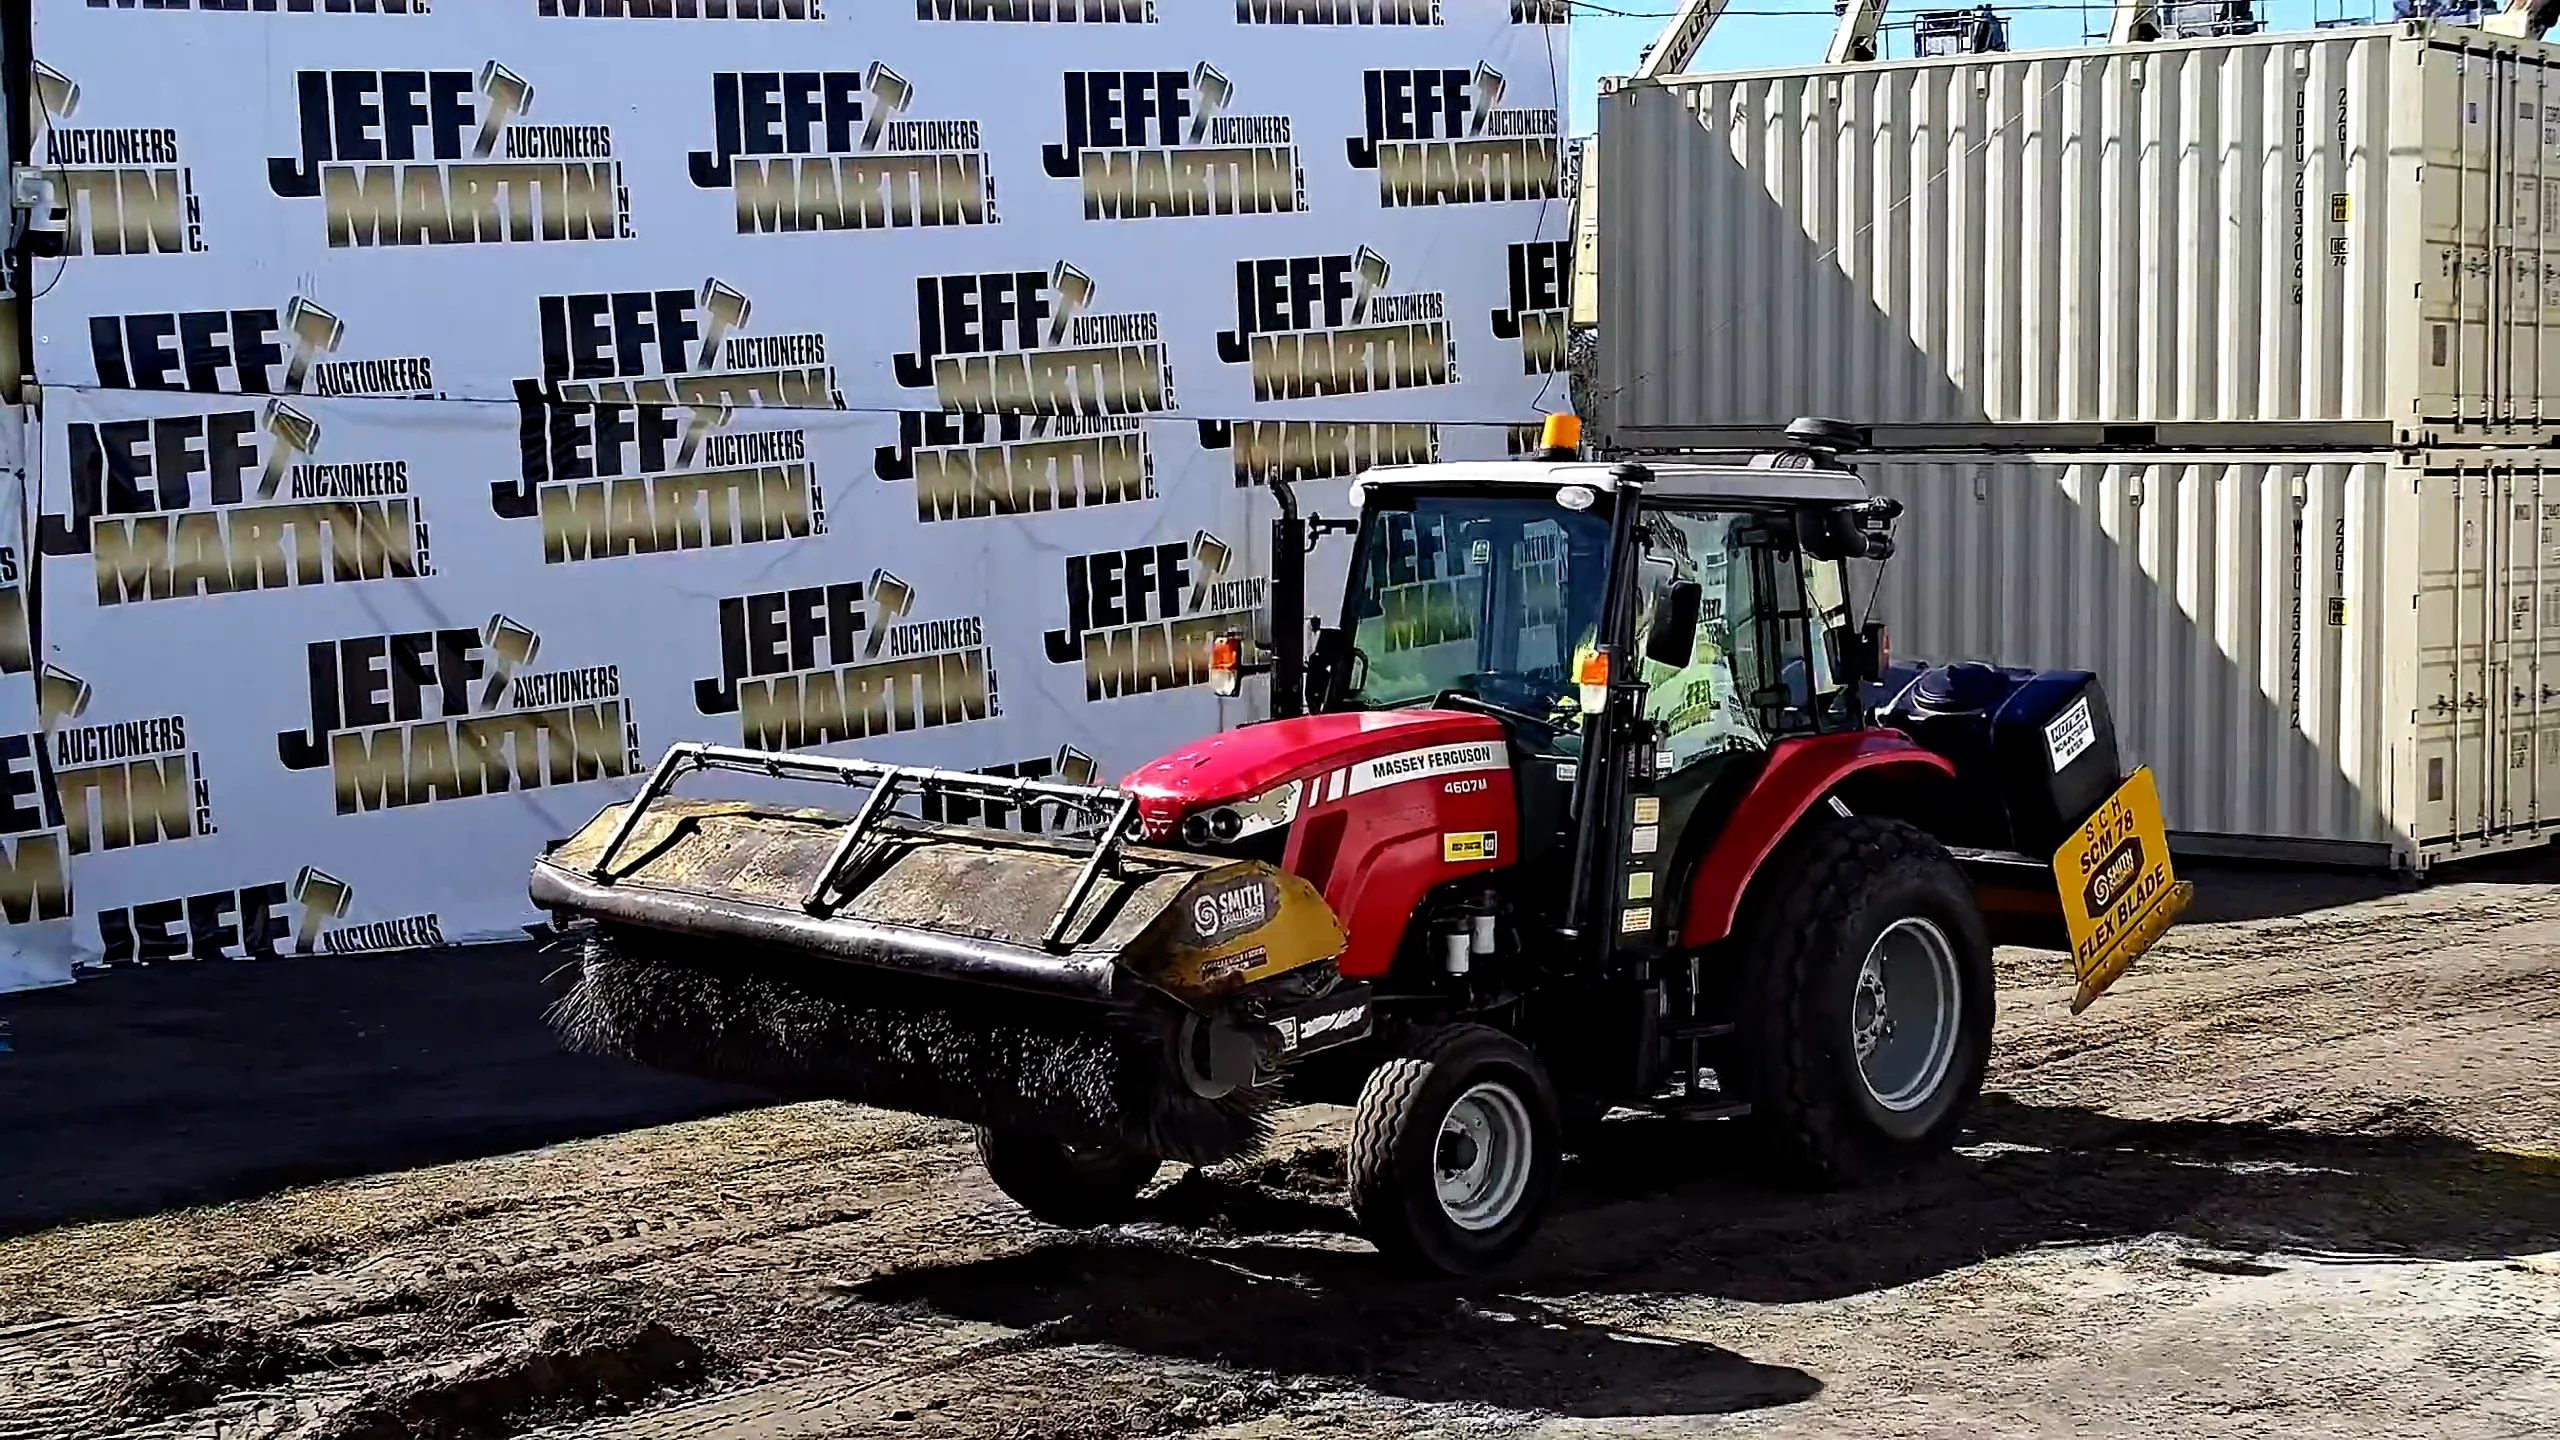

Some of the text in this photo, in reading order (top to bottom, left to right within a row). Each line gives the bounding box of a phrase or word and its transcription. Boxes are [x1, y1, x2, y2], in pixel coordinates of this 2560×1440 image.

[47, 129, 177, 164] AUCTIONEERS
[267, 71, 475, 197] JEFF
[506, 126, 610, 158] AUCTIONEERS
[688, 72, 864, 187] JEFF
[888, 121, 979, 151] AUCTIONEERS
[1042, 72, 1191, 177] JEFF
[1212, 117, 1290, 144] AUCTIONEERS
[1346, 70, 1471, 168] JEFF
[1488, 110, 1556, 136] AUCTIONEERS
[616, 161, 636, 238] INC.
[735, 154, 983, 234] MARTIN
[984, 152, 1001, 223] INC.
[1083, 148, 1293, 220] MARTIN
[1294, 146, 1309, 211] INC.
[1380, 138, 1558, 208] MARTIN
[1560, 137, 1568, 198] INC
[185, 167, 209, 252] INC.
[324, 163, 615, 247] MARTIN
[893, 272, 1050, 387] JEFF
[1073, 313, 1157, 344] AUCTIONEERS
[1216, 255, 1353, 363] JEFF
[1372, 293, 1443, 323] AUCTIONEERS
[316, 357, 431, 395] AUCTIONEERS
[512, 290, 699, 402] JEFF
[726, 335, 824, 369] AUCTIONEERS
[935, 345, 1163, 415] MARTIN
[1161, 343, 1180, 410] INC.
[1251, 322, 1445, 401] MARTIN
[1446, 321, 1460, 383] INC.
[42, 411, 259, 556] JEFF
[292, 462, 407, 498] AUCTIONEERS
[491, 404, 678, 518] JEFF
[705, 430, 804, 467] AUCTIONEERS
[915, 434, 1142, 523] MARTIN
[1142, 432, 1160, 499] INC.
[540, 463, 810, 564] MARTIN
[809, 462, 828, 534] INC.
[94, 499, 419, 607] MARTIN
[413, 497, 437, 577] INC.
[890, 617, 982, 656] AUCTIONEERS
[1044, 542, 1190, 664] JEFF
[694, 581, 865, 715] JEFF
[986, 647, 1003, 716] INC.
[278, 628, 484, 770] JEFF
[512, 665, 618, 708] AUCTIONEERS
[741, 649, 986, 751] MARTIN
[58, 716, 185, 766] AUCTIONEERS
[333, 701, 624, 815] MARTIN
[624, 698, 645, 775] INC.
[1372, 746, 1491, 778] MASSEY FERGUSON
[193, 752, 218, 835] INC.
[2080, 828, 2113, 875] SCM
[2115, 808, 2134, 838] 78
[2107, 849, 2134, 882] SMITH
[1219, 883, 1265, 913] SMITH
[2078, 913, 2116, 968] FLEX
[2117, 862, 2165, 928] BLADE
[323, 914, 442, 955] AUCTIONEERS
